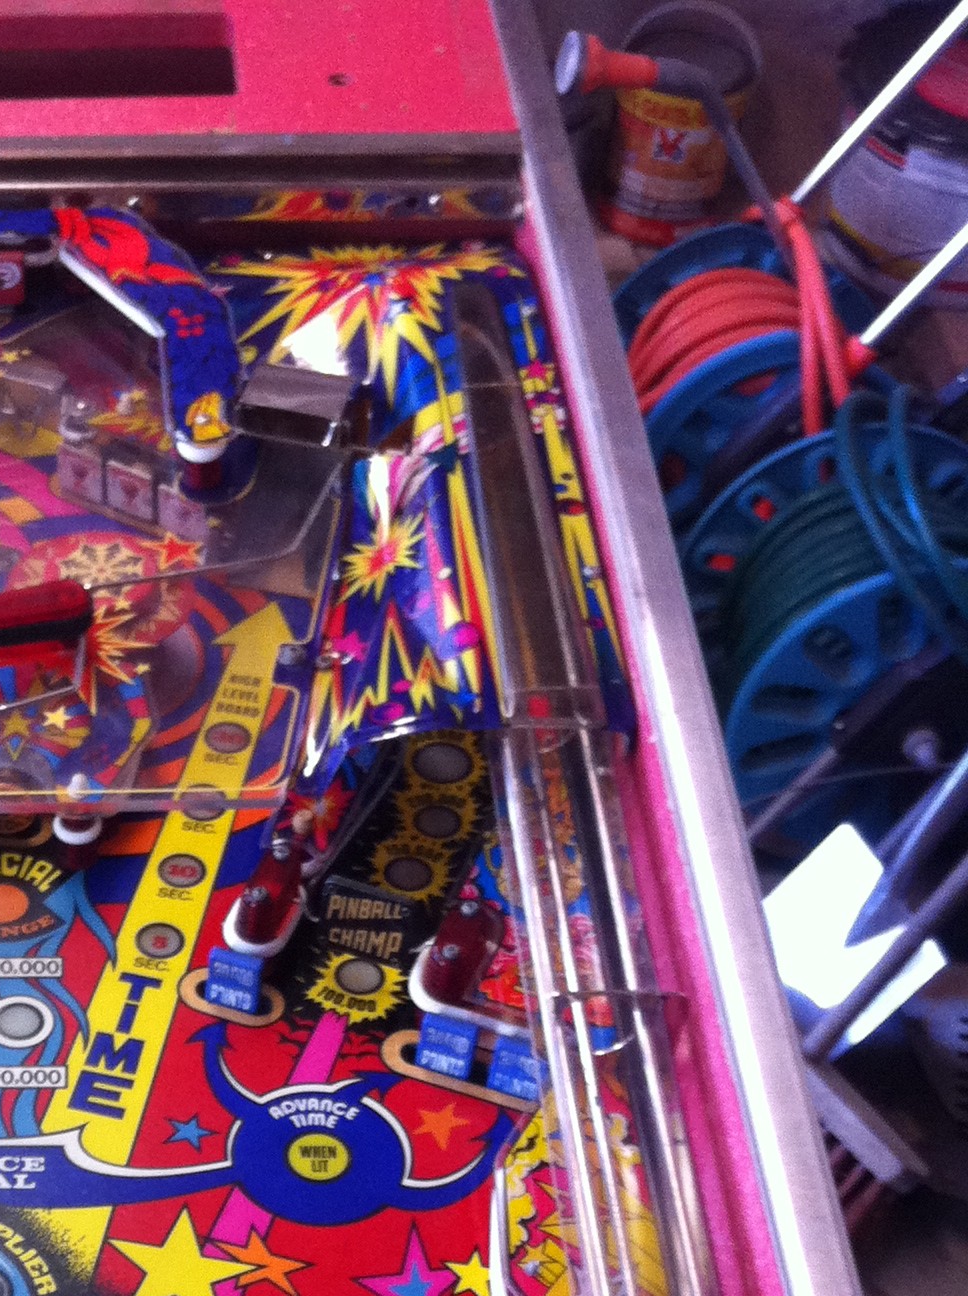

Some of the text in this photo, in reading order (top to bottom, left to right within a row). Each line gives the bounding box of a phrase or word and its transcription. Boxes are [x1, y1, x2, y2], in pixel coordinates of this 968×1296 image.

[326, 894, 403, 920] PINBALL
[328, 927, 403, 961] CHAMP
[67, 972, 164, 1121] TIME
[268, 1098, 361, 1121] ADVANCE
[288, 1113, 340, 1129] TIME
[299, 1145, 338, 1159] WHEN
[311, 1160, 330, 1174] LIT
